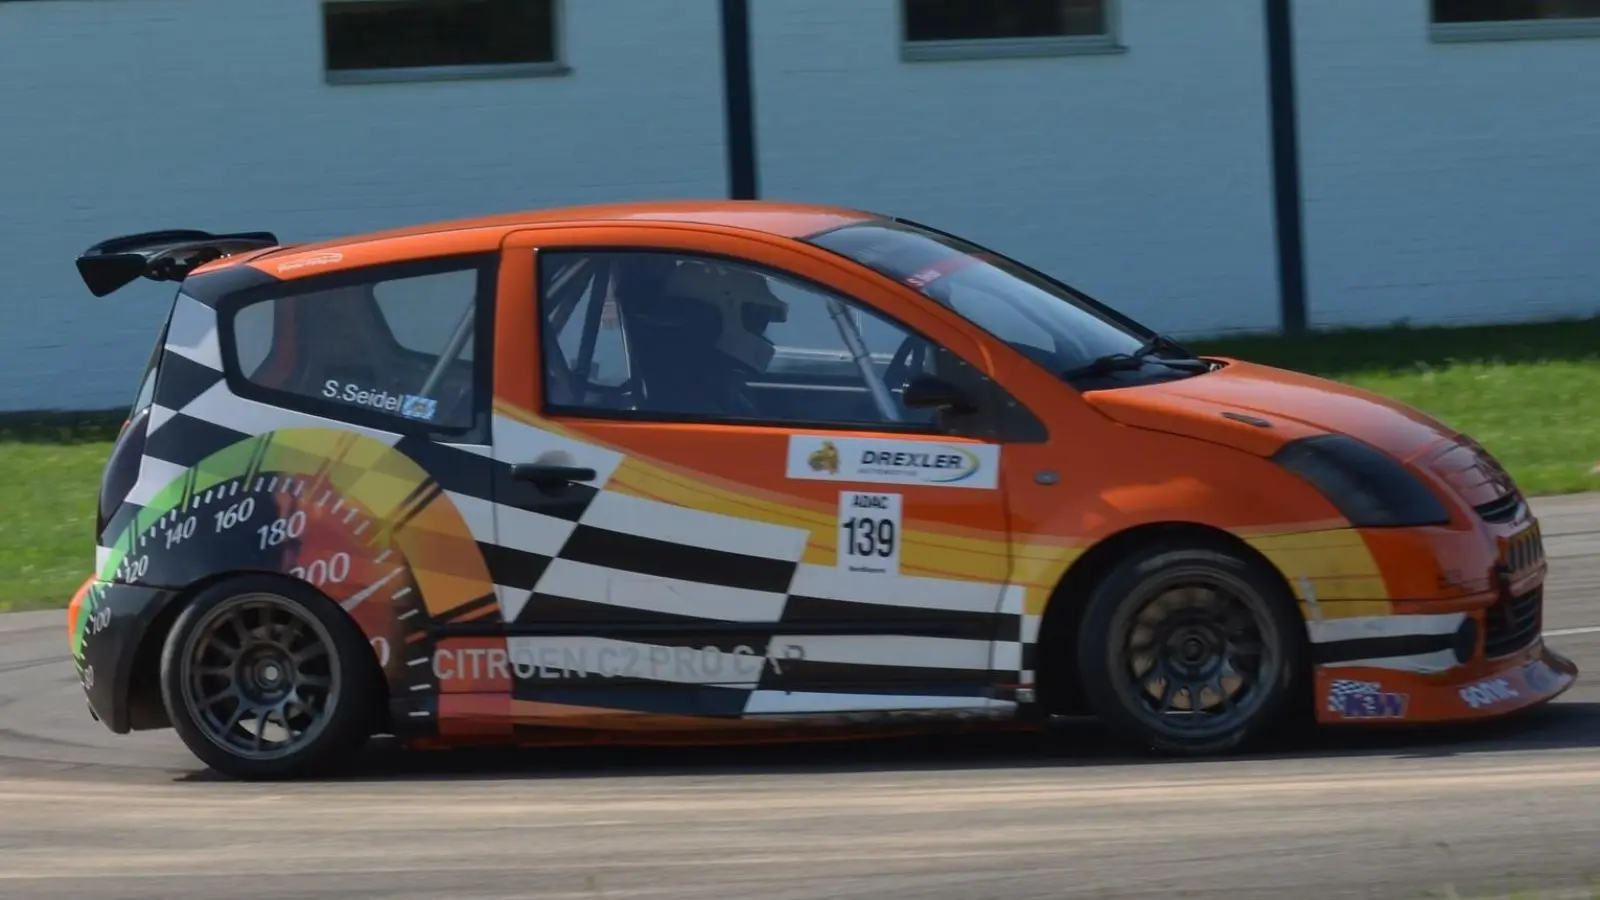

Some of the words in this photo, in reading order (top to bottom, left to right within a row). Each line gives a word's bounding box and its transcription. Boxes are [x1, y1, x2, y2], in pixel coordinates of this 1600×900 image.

[322, 379, 404, 412] S.Seidel
[861, 450, 962, 469] DREXLER
[214, 497, 255, 533] 160
[852, 494, 889, 509] ADAC
[165, 516, 197, 549] 140
[257, 511, 306, 550] 180
[842, 517, 895, 558] 139
[125, 555, 149, 584] 120
[92, 607, 111, 635] 100
[598, 646, 640, 678] C2
[649, 645, 722, 679] PRO
